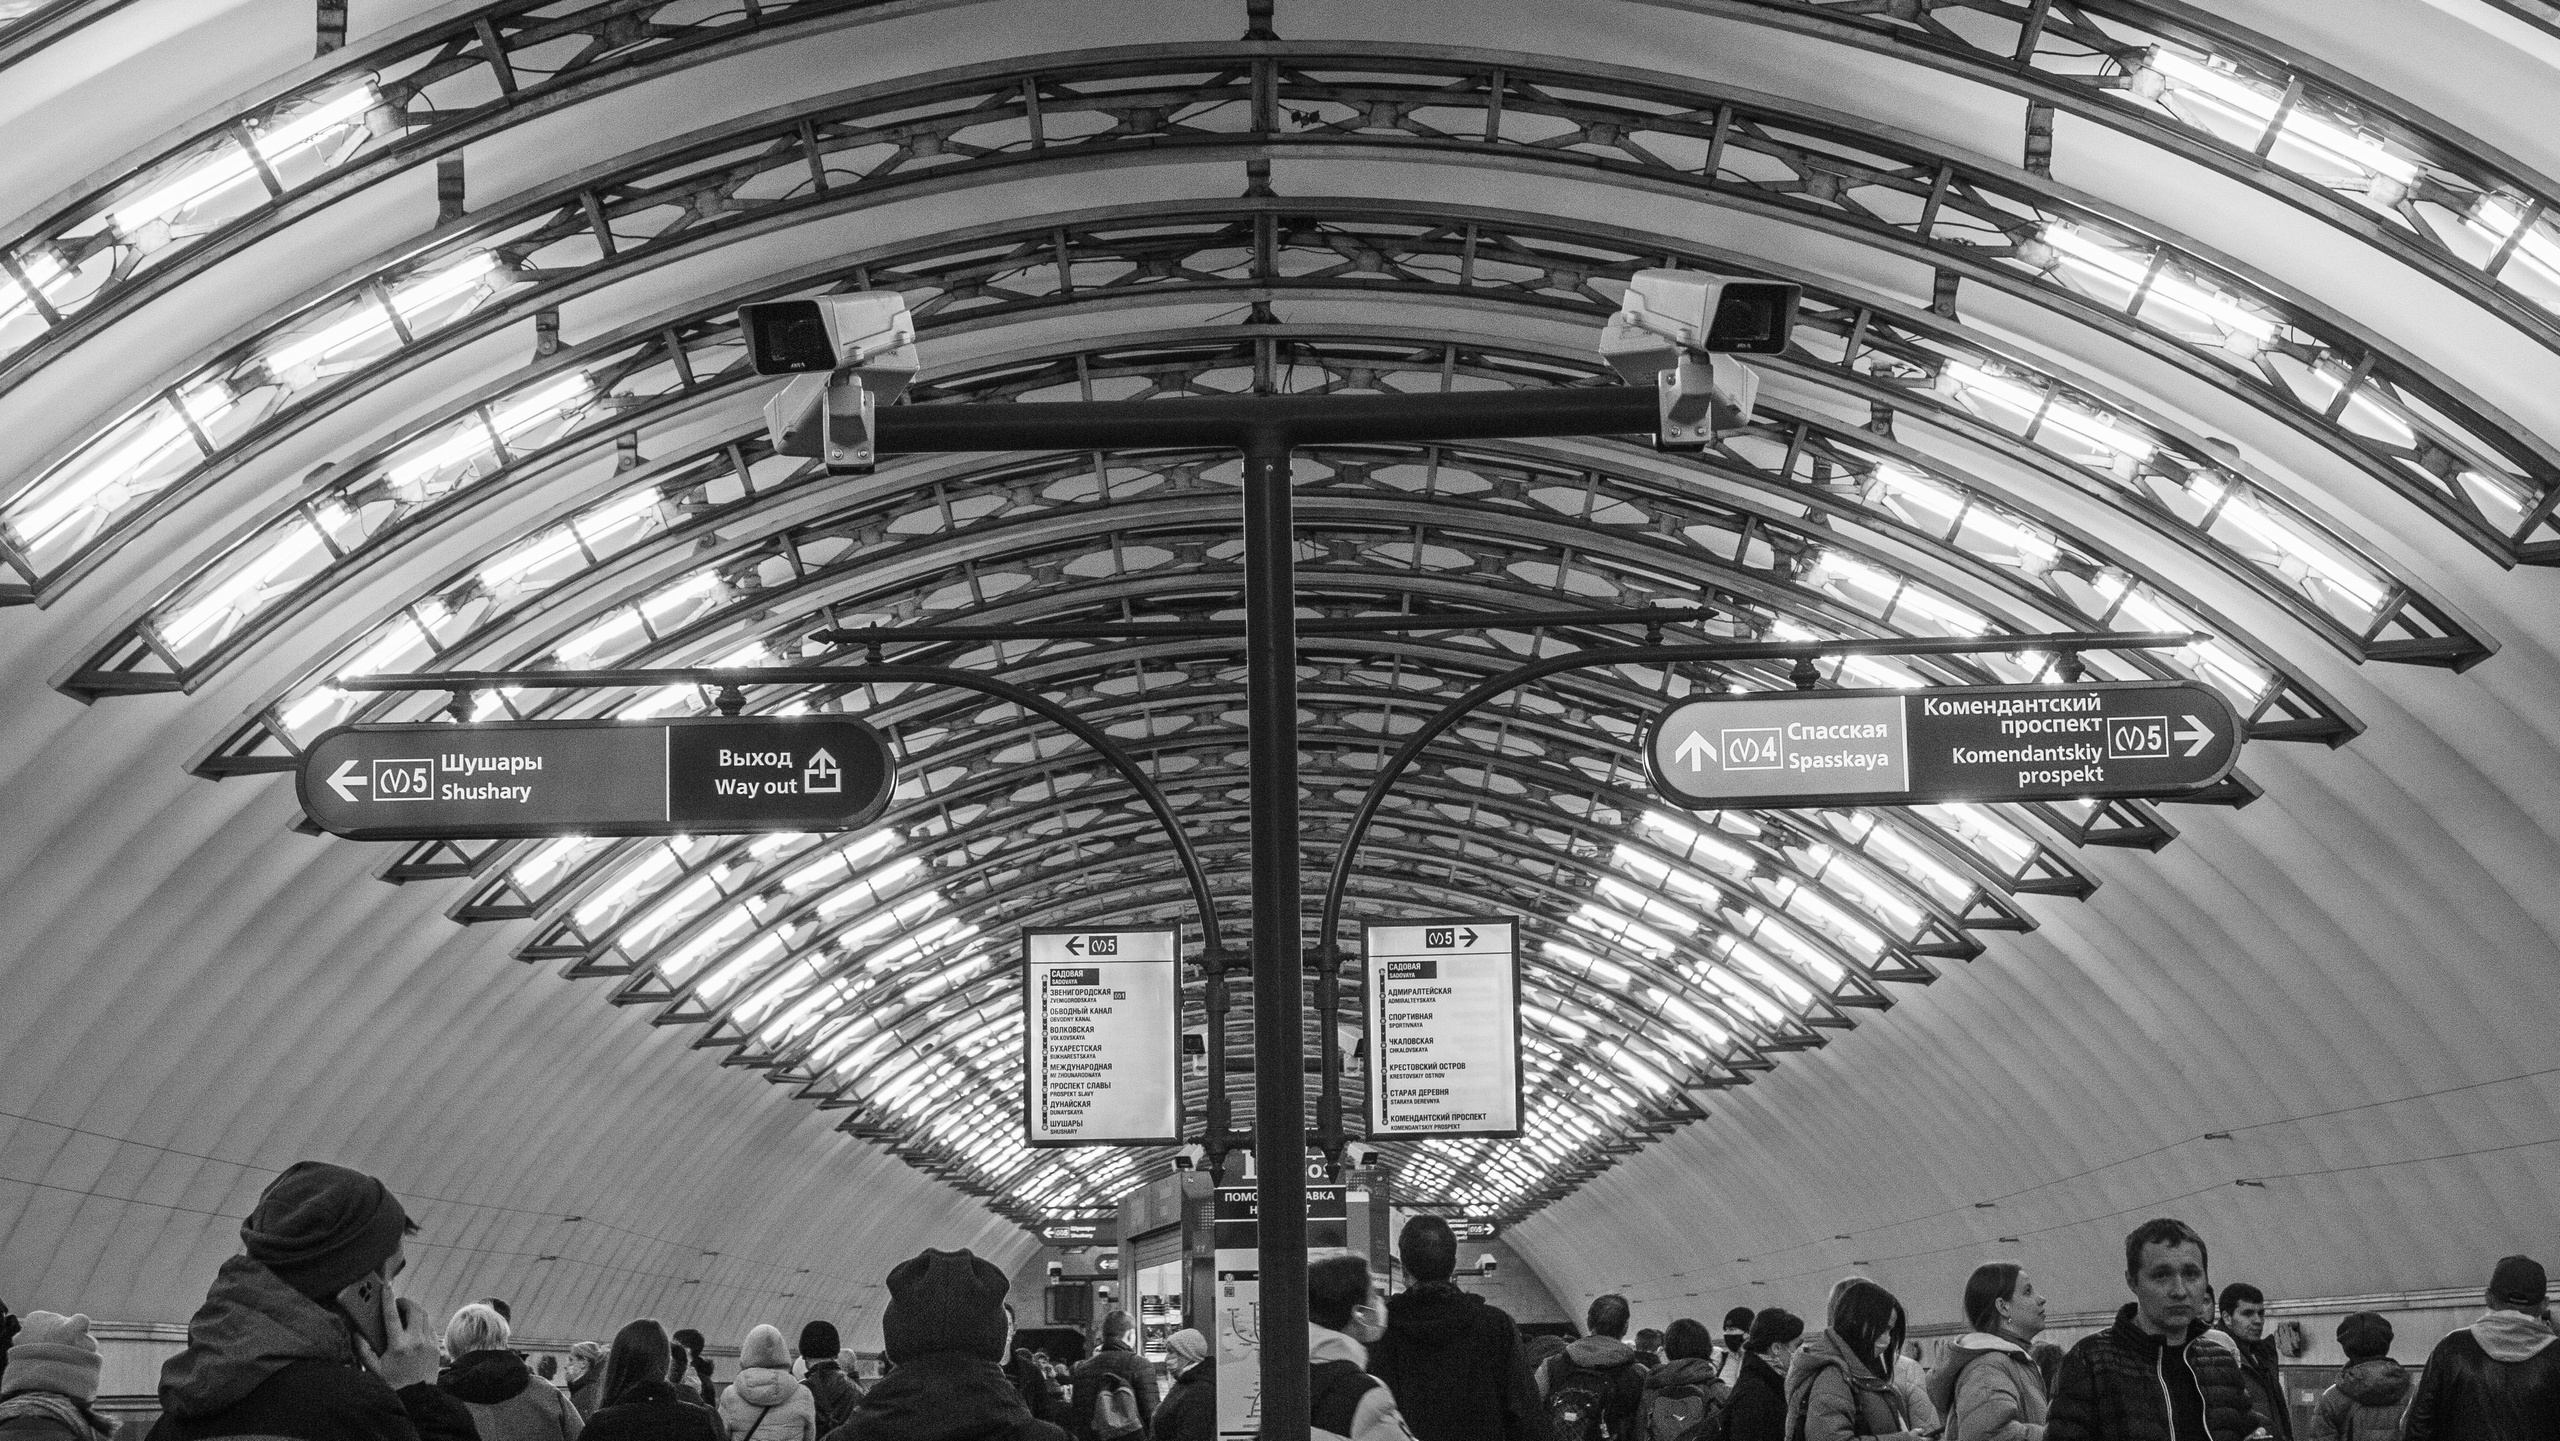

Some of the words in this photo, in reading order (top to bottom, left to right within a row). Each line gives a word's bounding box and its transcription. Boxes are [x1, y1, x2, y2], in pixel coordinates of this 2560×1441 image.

[1924, 692, 2102, 717] Комендантский
[1787, 722, 1888, 741] Спасская
[2001, 716, 2103, 738] проспект
[719, 749, 793, 769] Выход
[1952, 743, 2103, 765] Komendantskiy
[441, 753, 543, 777] Шушары
[1788, 750, 1889, 773] Spasskaya
[2018, 764, 2104, 788] prospekt
[441, 782, 532, 803] Shushary
[714, 778, 760, 799] Way
[763, 778, 798, 794] out
[1388, 962, 1421, 971] САДОВАЯ
[1051, 969, 1084, 978] САДОВАЯ
[1050, 988, 1111, 996] ЗВЕНИГОРОДСКАЯ
[1388, 986, 1452, 996] АДМИРАЛТЕЙСКАЯ
[1050, 1006, 1088, 1016] ОБВОДНЫЙ
[1090, 1007, 1112, 1015] КАНАЛ
[1388, 1013, 1433, 1021] СПОРТИВНАЯ
[1389, 1037, 1434, 1045] ЧКАЛОВСКАЯ
[1050, 1044, 1102, 1052] БУХАРЕСТСКАЯ
[1050, 1063, 1112, 1071] МЕЖДУНАРОДНАЯ
[1389, 1062, 1437, 1071] КРЕСТОВСКИЙ
[1439, 1062, 1466, 1070] ОСТРОВ
[1418, 1088, 1449, 1097] ДЕРЕВНЯ
[1050, 1099, 1091, 1109] ДУНАЙСКАЯ
[1390, 1113, 1450, 1122] КОМЕНДАНТСКИЙ
[1451, 1113, 1487, 1121] ПРОСПЕКТ
[1224, 1192, 1258, 1202] ПОМО
[1305, 1191, 1335, 1200] АВКА
